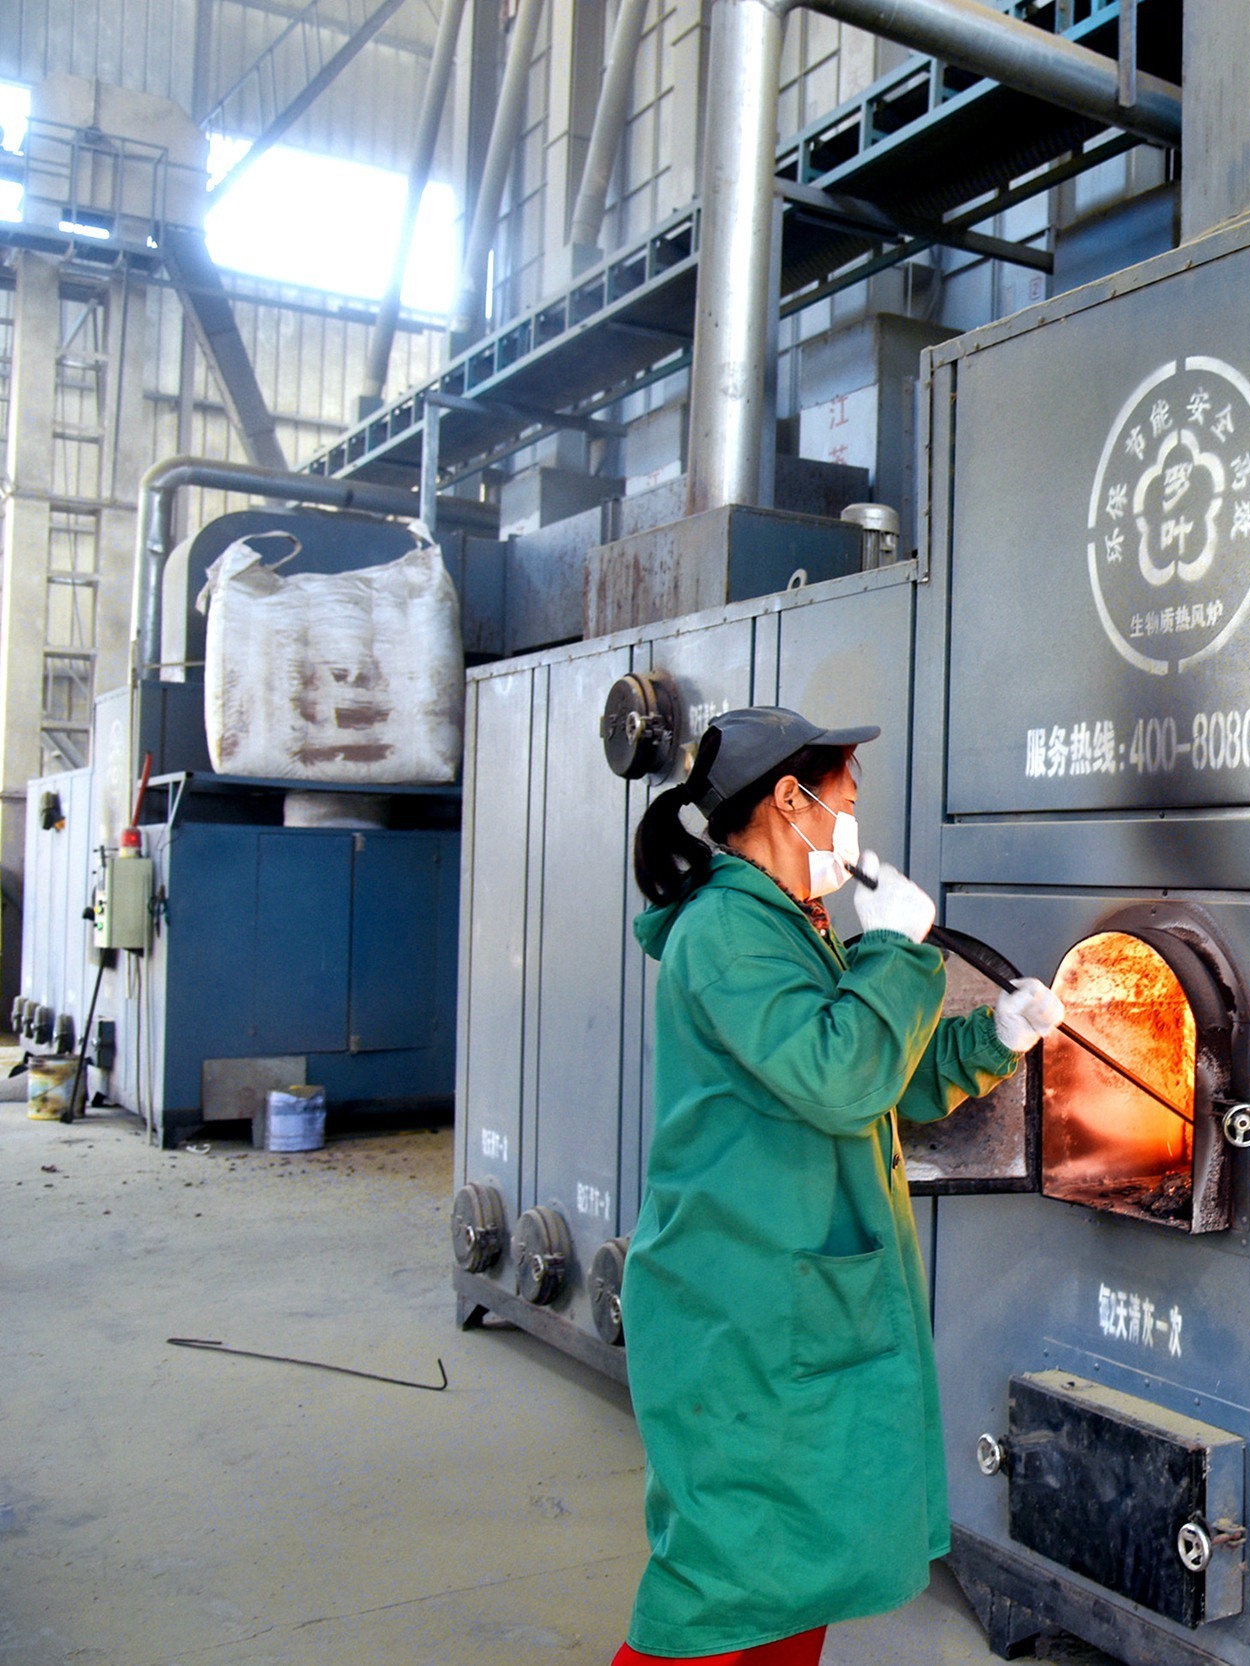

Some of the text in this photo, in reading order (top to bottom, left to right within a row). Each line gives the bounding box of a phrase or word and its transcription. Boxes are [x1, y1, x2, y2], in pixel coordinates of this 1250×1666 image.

[1129, 600, 1224, 639] 生物质热风炉
